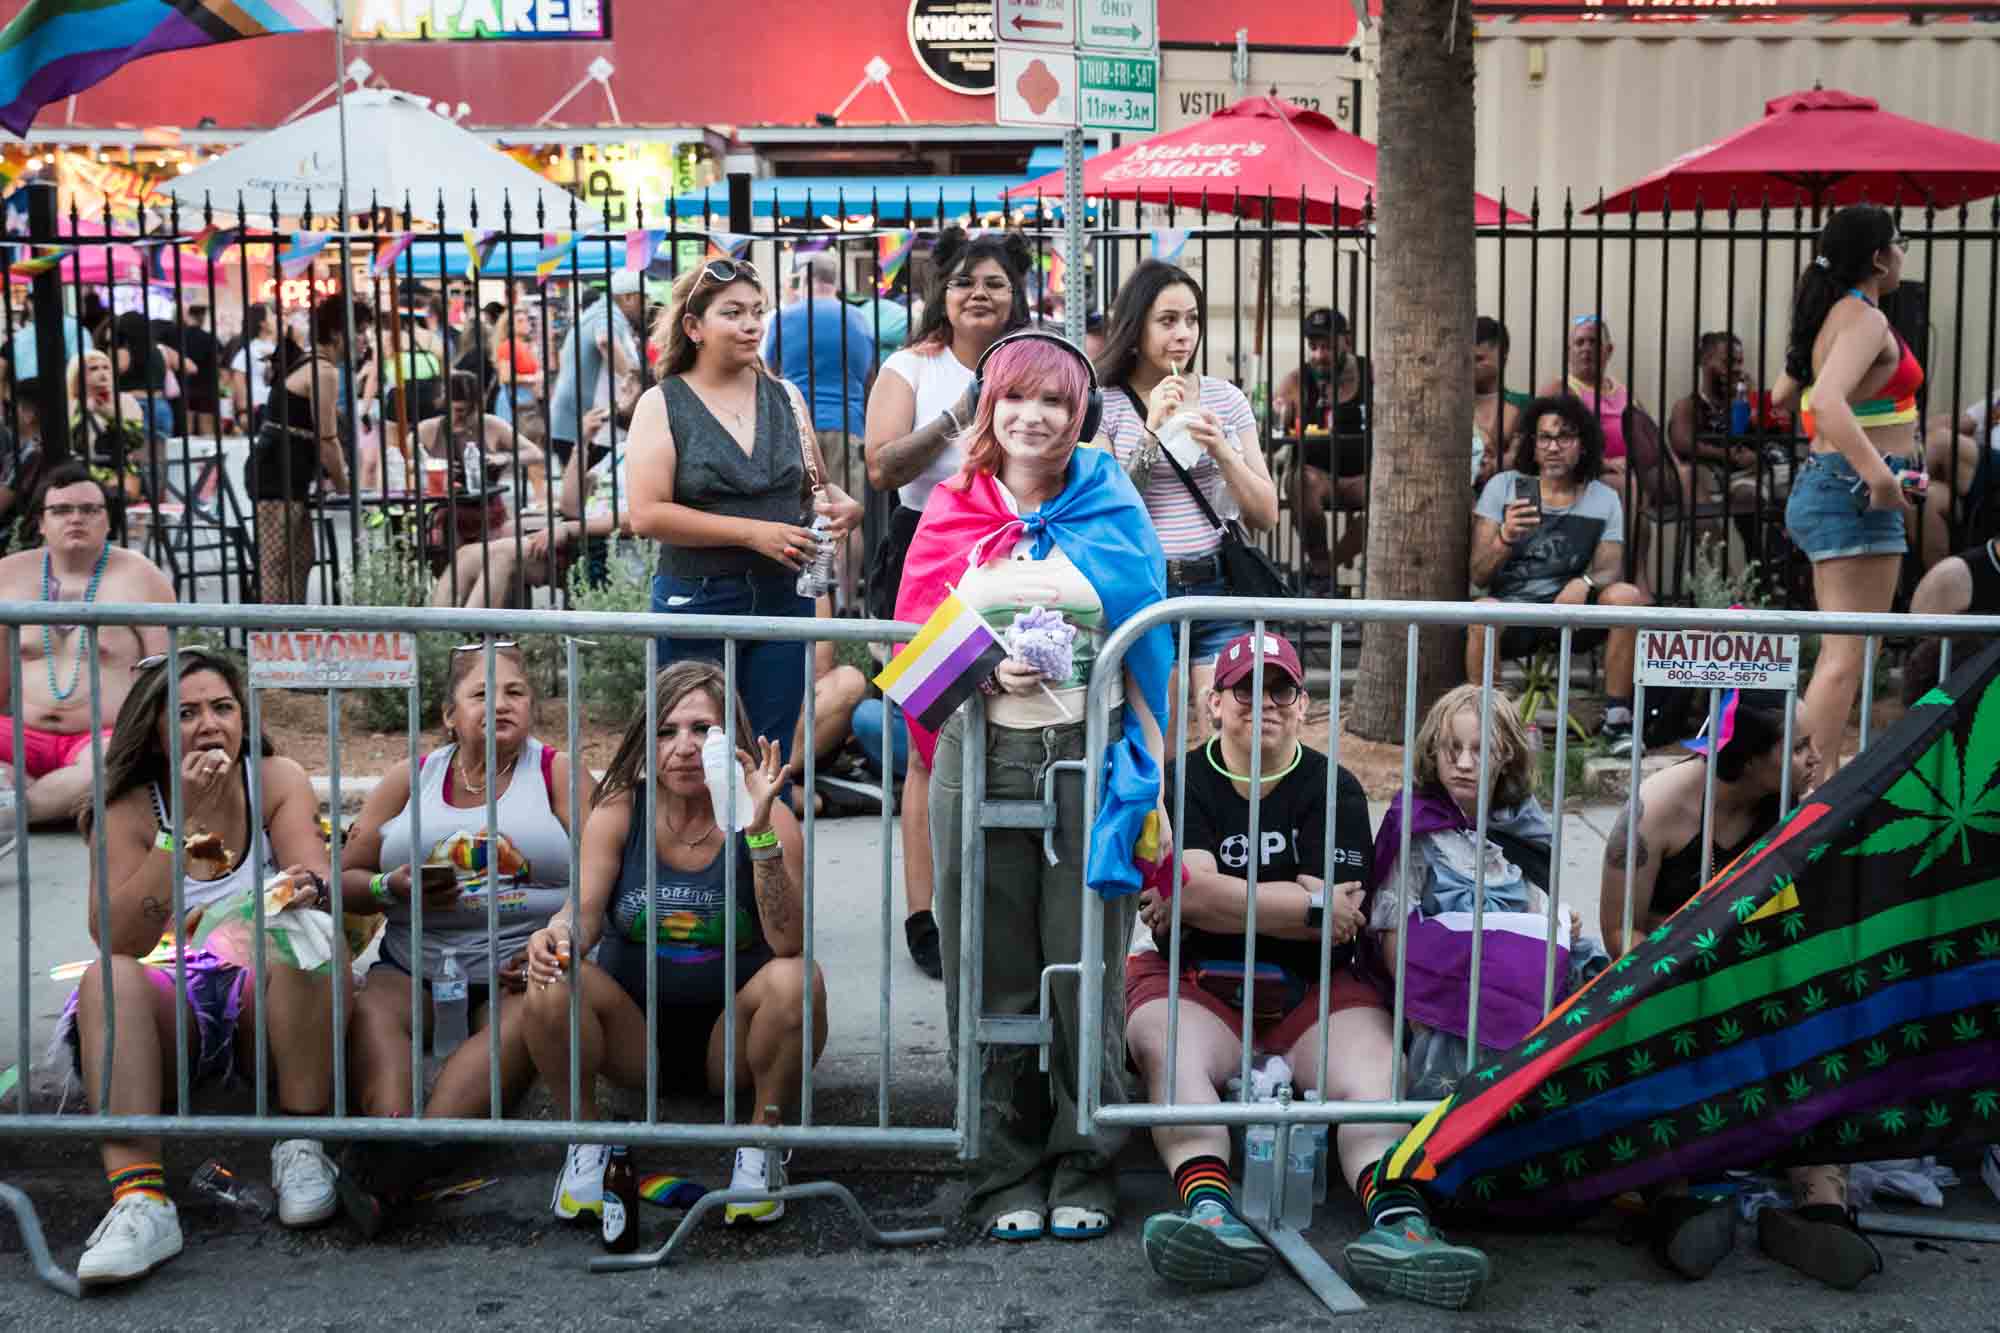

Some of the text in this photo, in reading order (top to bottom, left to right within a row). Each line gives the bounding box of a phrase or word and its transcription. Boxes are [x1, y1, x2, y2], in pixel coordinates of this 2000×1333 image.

[1125, 141, 1267, 161] Maker's
[251, 633, 409, 661] NATIONAL
[1648, 633, 1793, 663] NATIONAL
[1647, 660, 1791, 672] RENT-A-FENCE
[1667, 670, 1768, 682] 800-352-5675
